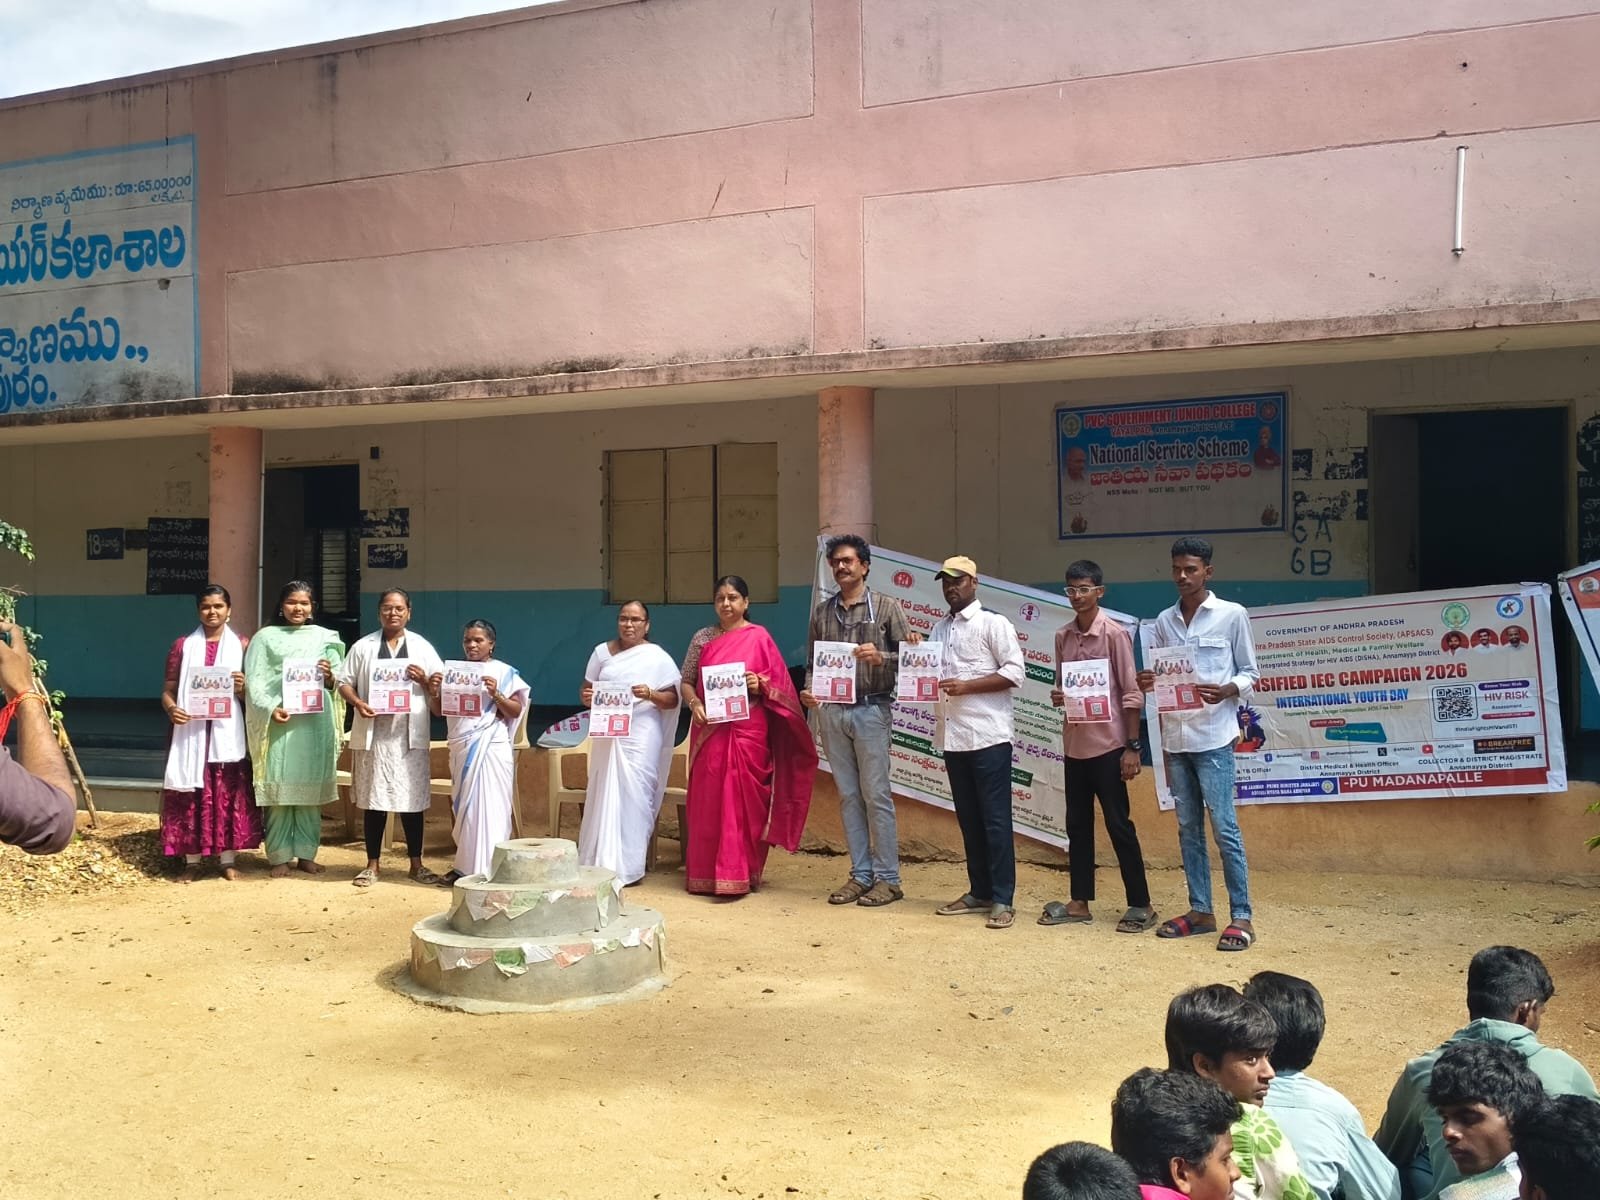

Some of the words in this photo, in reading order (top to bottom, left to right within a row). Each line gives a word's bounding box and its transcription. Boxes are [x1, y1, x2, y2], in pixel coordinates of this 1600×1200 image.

[1106, 409, 1172, 426] GOVERNMENT
[1174, 406, 1210, 422] JUNIOR
[1213, 402, 1256, 419] COLLEGE
[1089, 441, 1144, 465] National
[1147, 439, 1193, 461] Service
[1198, 437, 1249, 458] Scheme
[1155, 463, 1192, 483] సేవా
[1148, 486, 1163, 494] NOT
[1195, 484, 1211, 493] YOU
[1291, 547, 1332, 576] 6B
[1265, 625, 1317, 637] GOVERNMENT
[1319, 624, 1330, 632] OF
[1331, 621, 1366, 631] ANDHRA
[1367, 618, 1405, 628] PRADESH
[1255, 642, 1267, 650] hra
[1267, 640, 1296, 650] Pradesh
[1297, 638, 1317, 647] State
[1318, 635, 1336, 645] AIDS
[1337, 633, 1365, 643] Control
[1396, 628, 1435, 640] (APSACS)
[1257, 651, 1295, 661] epartment
[1332, 646, 1361, 655] Medical
[1368, 643, 1394, 653] Family
[1395, 641, 1425, 650] Welfare
[1260, 660, 1291, 670] Integrated
[1291, 658, 1316, 668] Strategy
[1317, 657, 1326, 665] for
[1326, 656, 1338, 664] HIV
[1338, 654, 1353, 663] AIDS
[1418, 648, 1441, 658] District
[1252, 675, 1308, 693] NSIFIED
[1311, 672, 1336, 689] IEC
[1338, 665, 1423, 687] CAMPAIGN
[1425, 662, 1468, 681] 2026
[1276, 692, 1352, 709] INTERNATIONAL
[1353, 690, 1389, 705] YOUTH
[1390, 688, 1410, 701] DAY
[1484, 692, 1503, 701] HIV
[1504, 690, 1529, 700] RISK
[1324, 762, 1348, 770] Medical
[1418, 757, 1459, 765] COLLECTOR
[1466, 755, 1497, 763] DISTRICT
[1499, 752, 1543, 761] MAGISTRATE
[1357, 768, 1381, 776] District
[1372, 771, 1484, 787] MADANAPALLE
